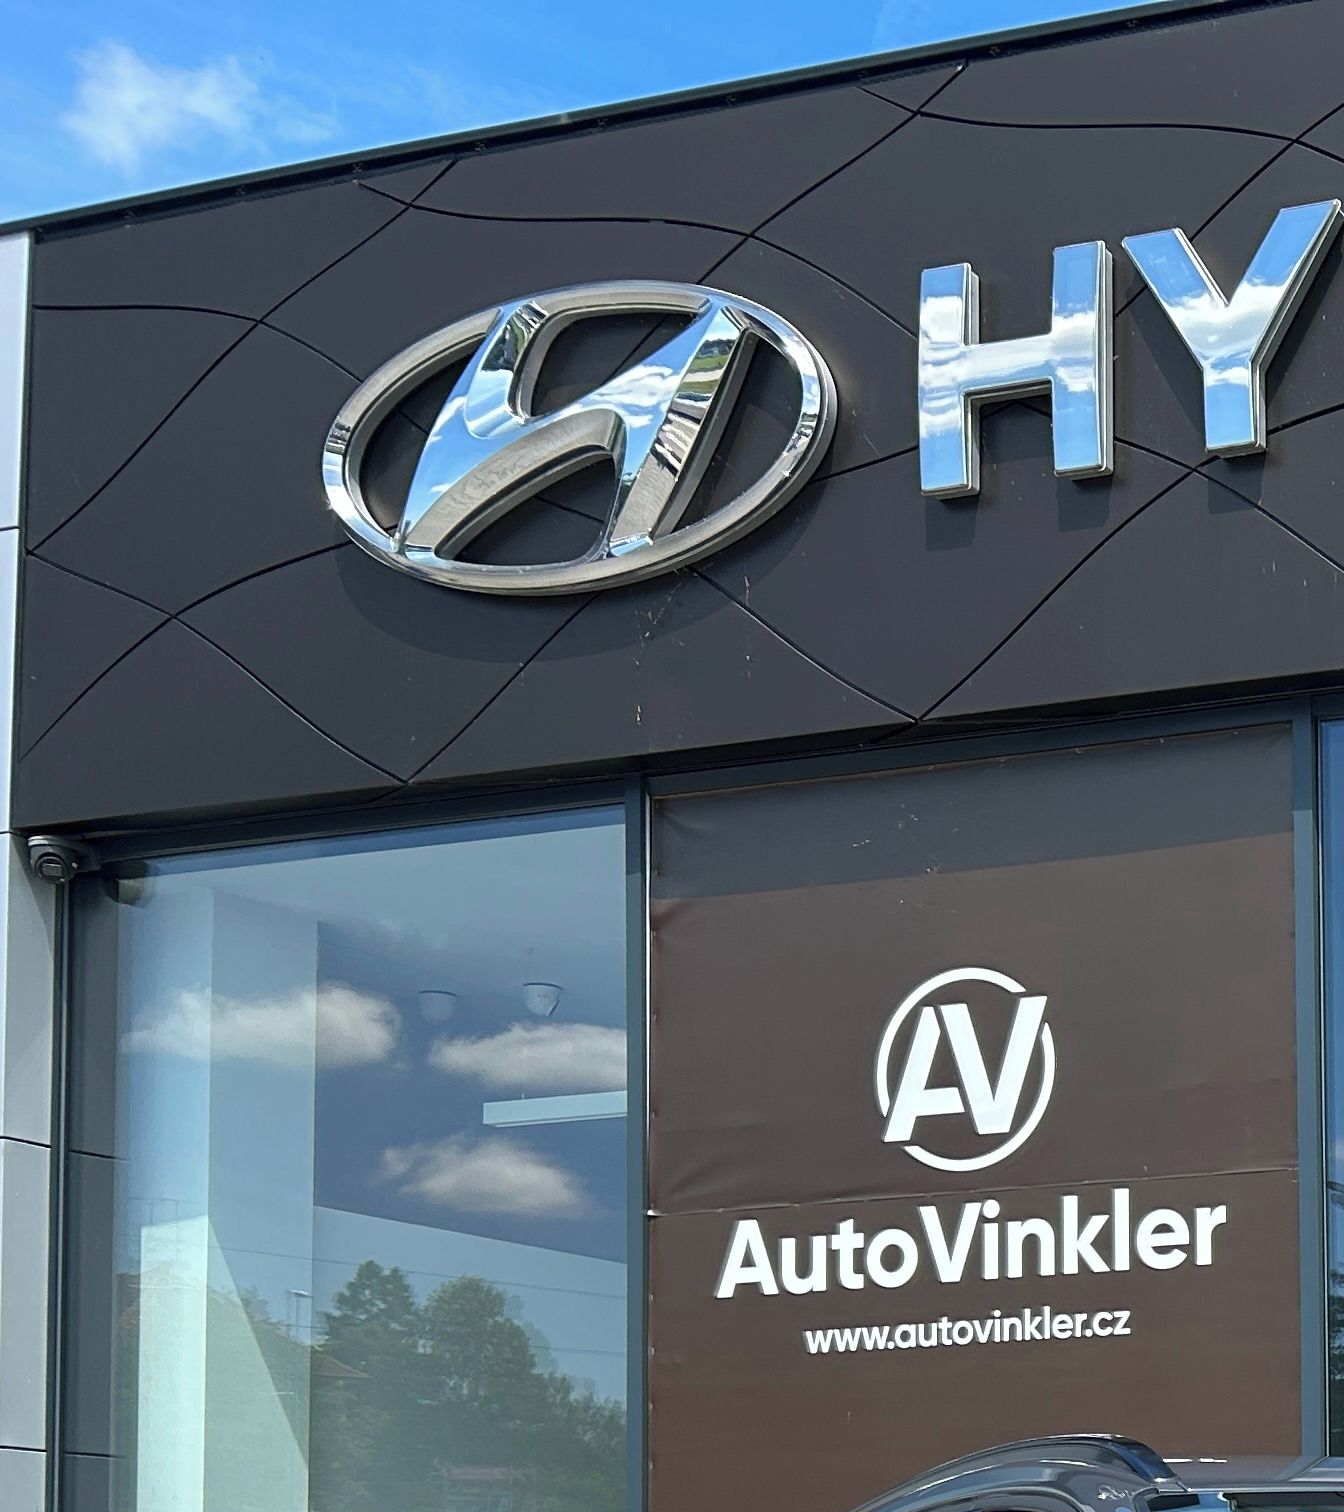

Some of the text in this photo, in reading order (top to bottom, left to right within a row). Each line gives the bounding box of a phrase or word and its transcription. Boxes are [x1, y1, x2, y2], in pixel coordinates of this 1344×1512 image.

[882, 995, 1047, 1142] AV
[714, 1188, 1227, 1299] AutoVinkler
[804, 1306, 1131, 1354] www.autovinkler.cz
